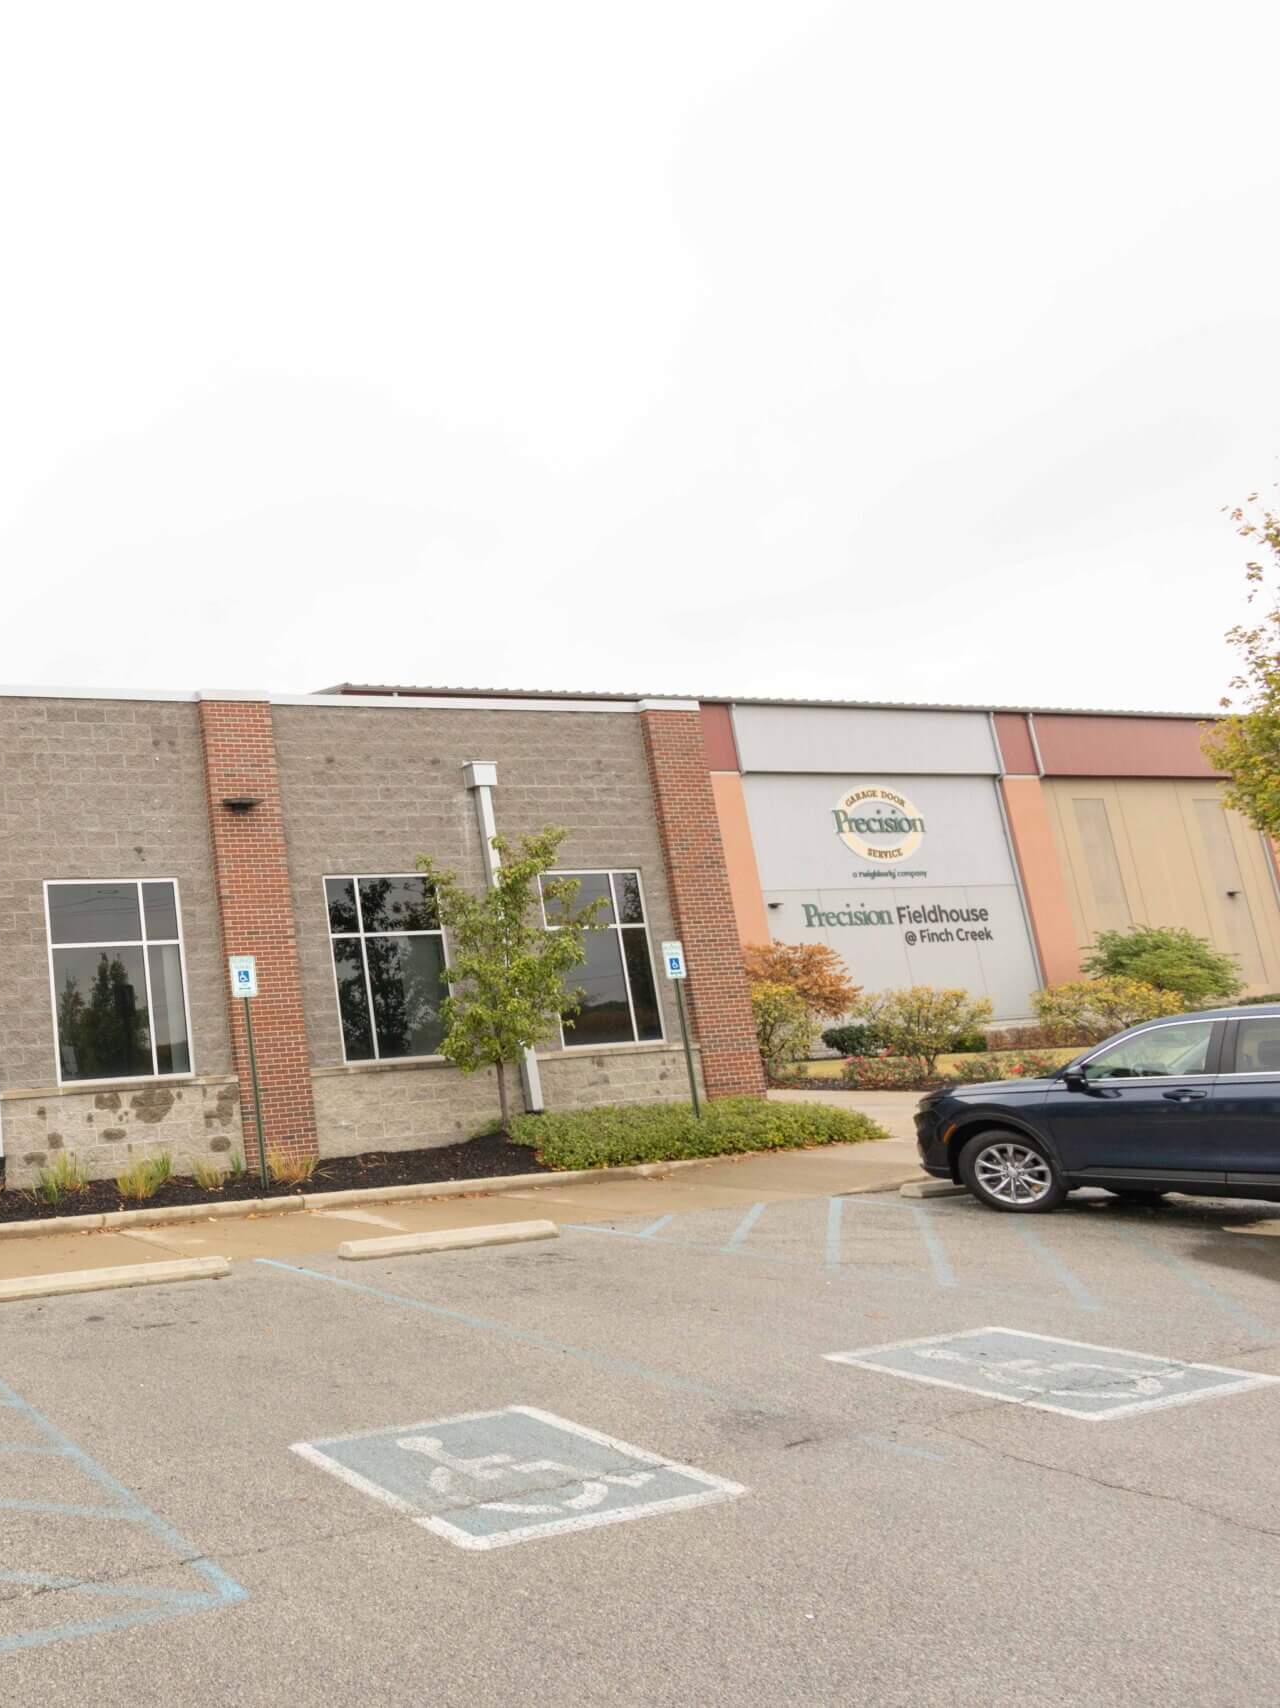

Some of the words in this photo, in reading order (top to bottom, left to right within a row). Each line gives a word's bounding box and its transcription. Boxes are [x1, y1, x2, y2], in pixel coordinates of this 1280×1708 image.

[845, 789, 878, 807] GARAGE
[880, 790, 906, 807] DOOR
[831, 809, 926, 834] Precision
[867, 847, 904, 859] SERVICE
[801, 902, 895, 928] Precision
[896, 904, 990, 925] Fieldhouse
[905, 930, 918, 946] @
[919, 928, 955, 943] Finch
[956, 926, 994, 942] Creek
